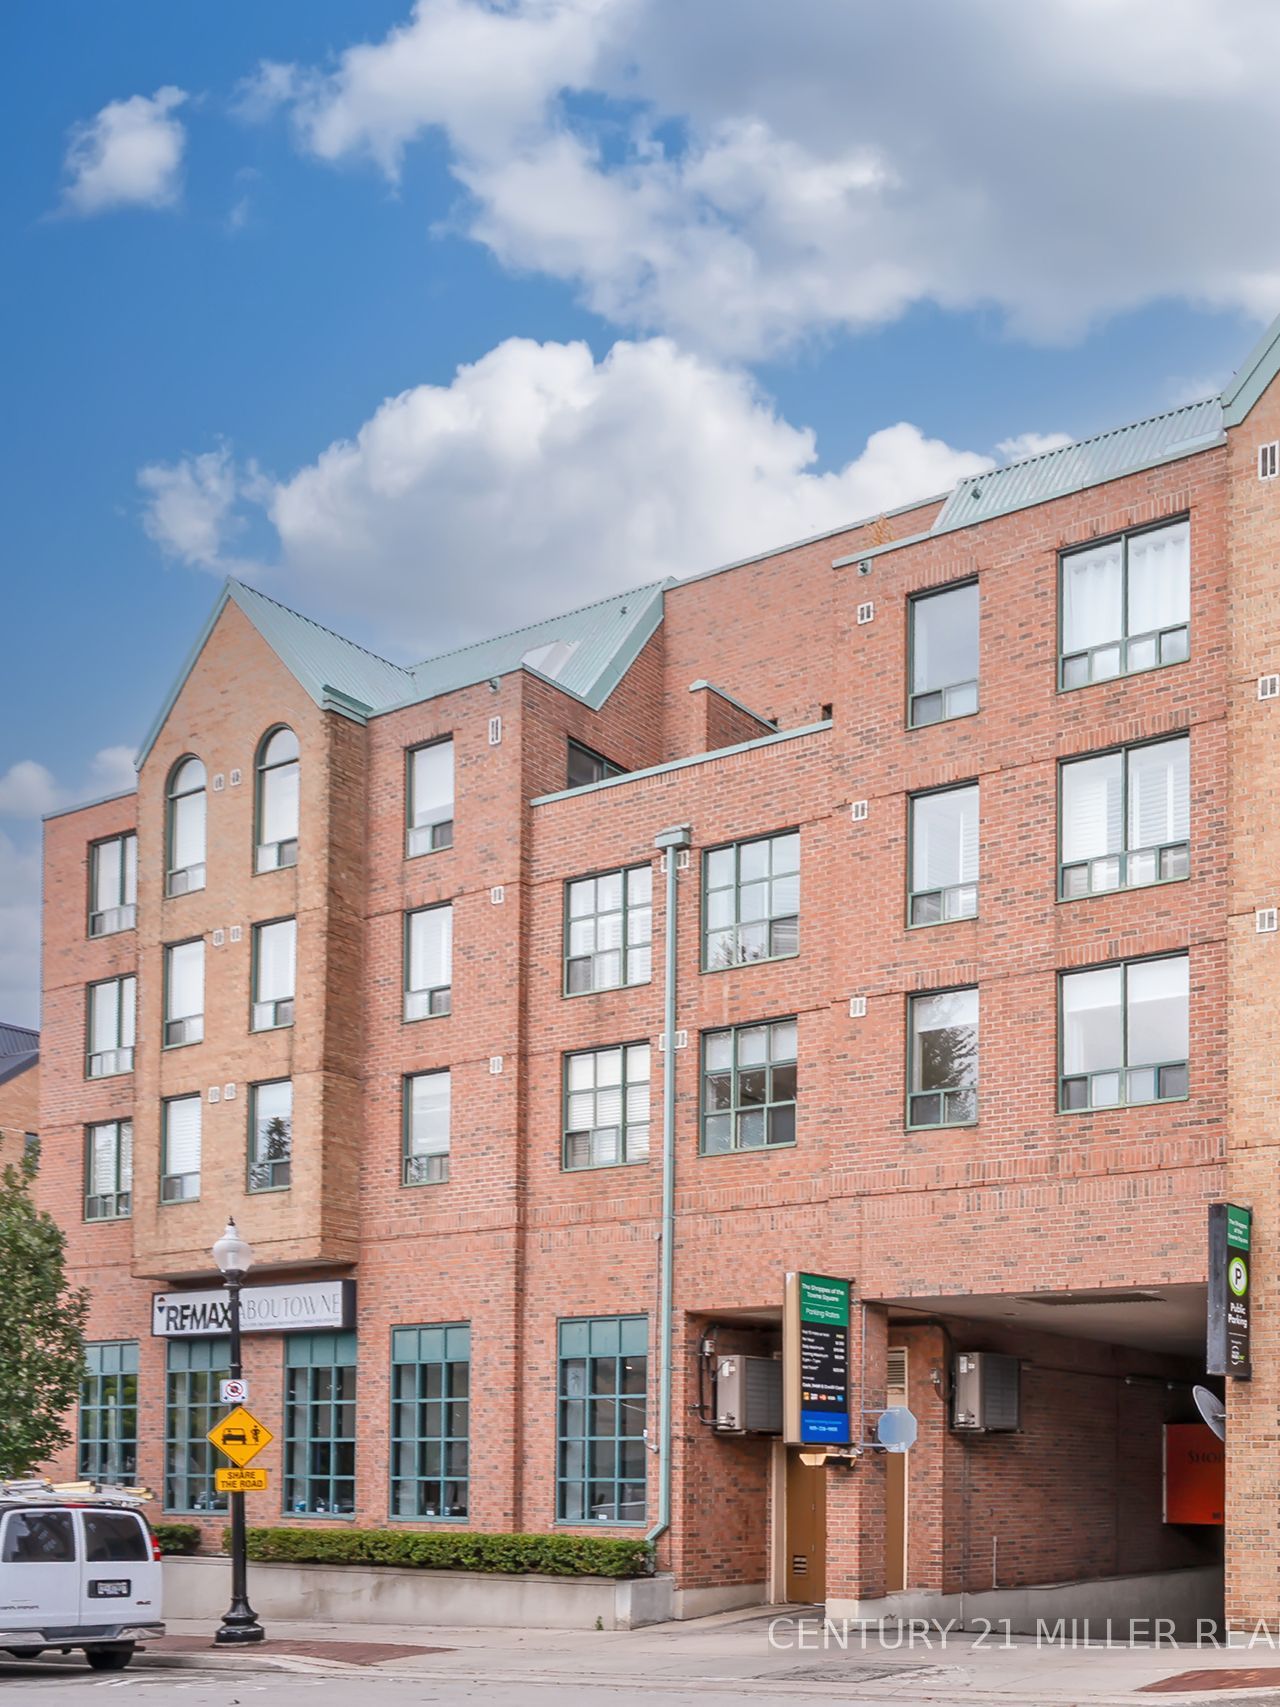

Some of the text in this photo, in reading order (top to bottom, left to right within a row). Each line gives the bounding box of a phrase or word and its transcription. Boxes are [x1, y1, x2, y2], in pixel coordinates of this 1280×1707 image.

[1235, 1268, 1242, 1285] P
[806, 1307, 825, 1319] Parking
[1230, 1302, 1246, 1315] Public
[1228, 1313, 1248, 1329] Parking
[227, 1471, 256, 1480] SHARE
[220, 1480, 263, 1488] THE ROAD
